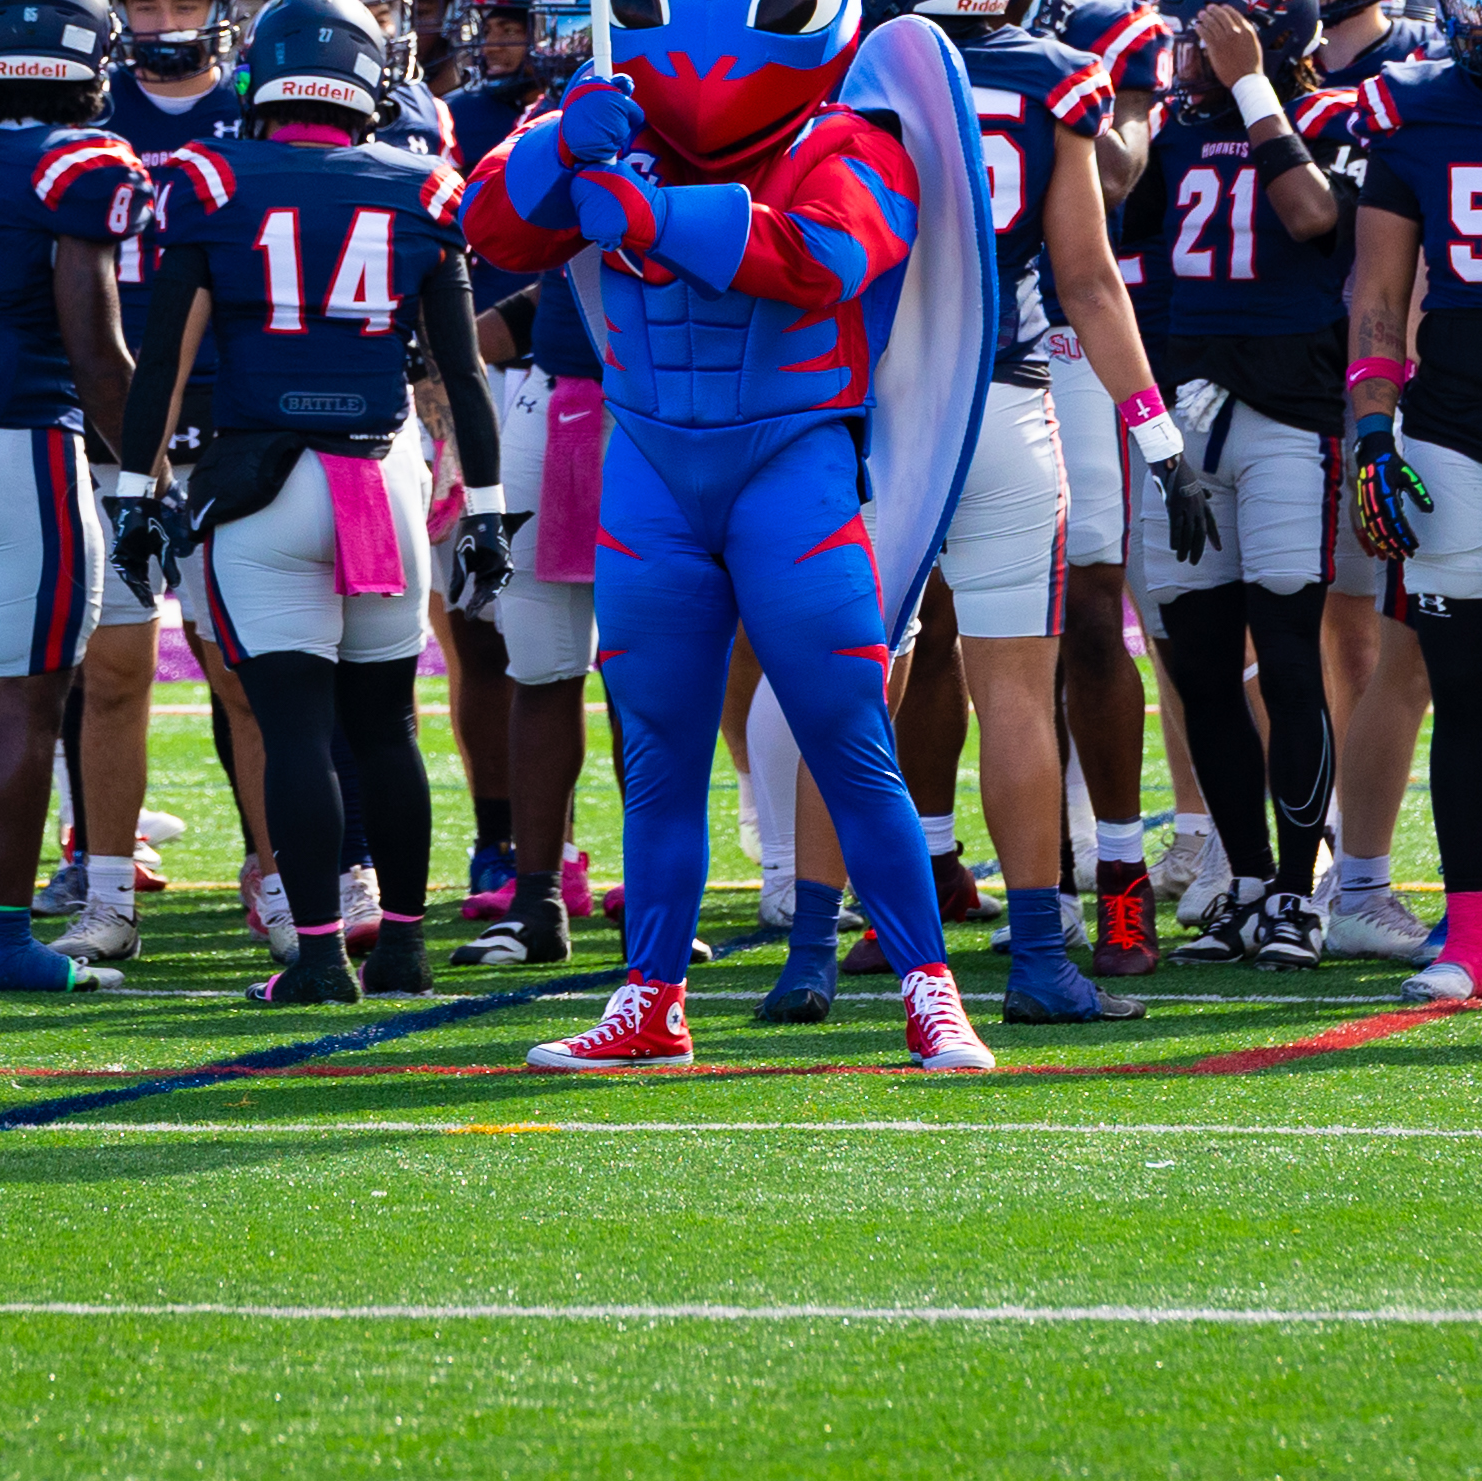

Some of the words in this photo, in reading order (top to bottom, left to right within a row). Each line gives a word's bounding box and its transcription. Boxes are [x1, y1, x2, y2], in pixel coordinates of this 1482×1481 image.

[318, 27, 333, 43] 27
[281, 80, 356, 103] Riddell
[1201, 140, 1250, 159] HORNETS
[107, 182, 136, 235] 8
[1172, 165, 1259, 281] 21
[251, 207, 404, 337] 14
[1049, 333, 1083, 362] SU
[287, 397, 360, 412] BATTLE
